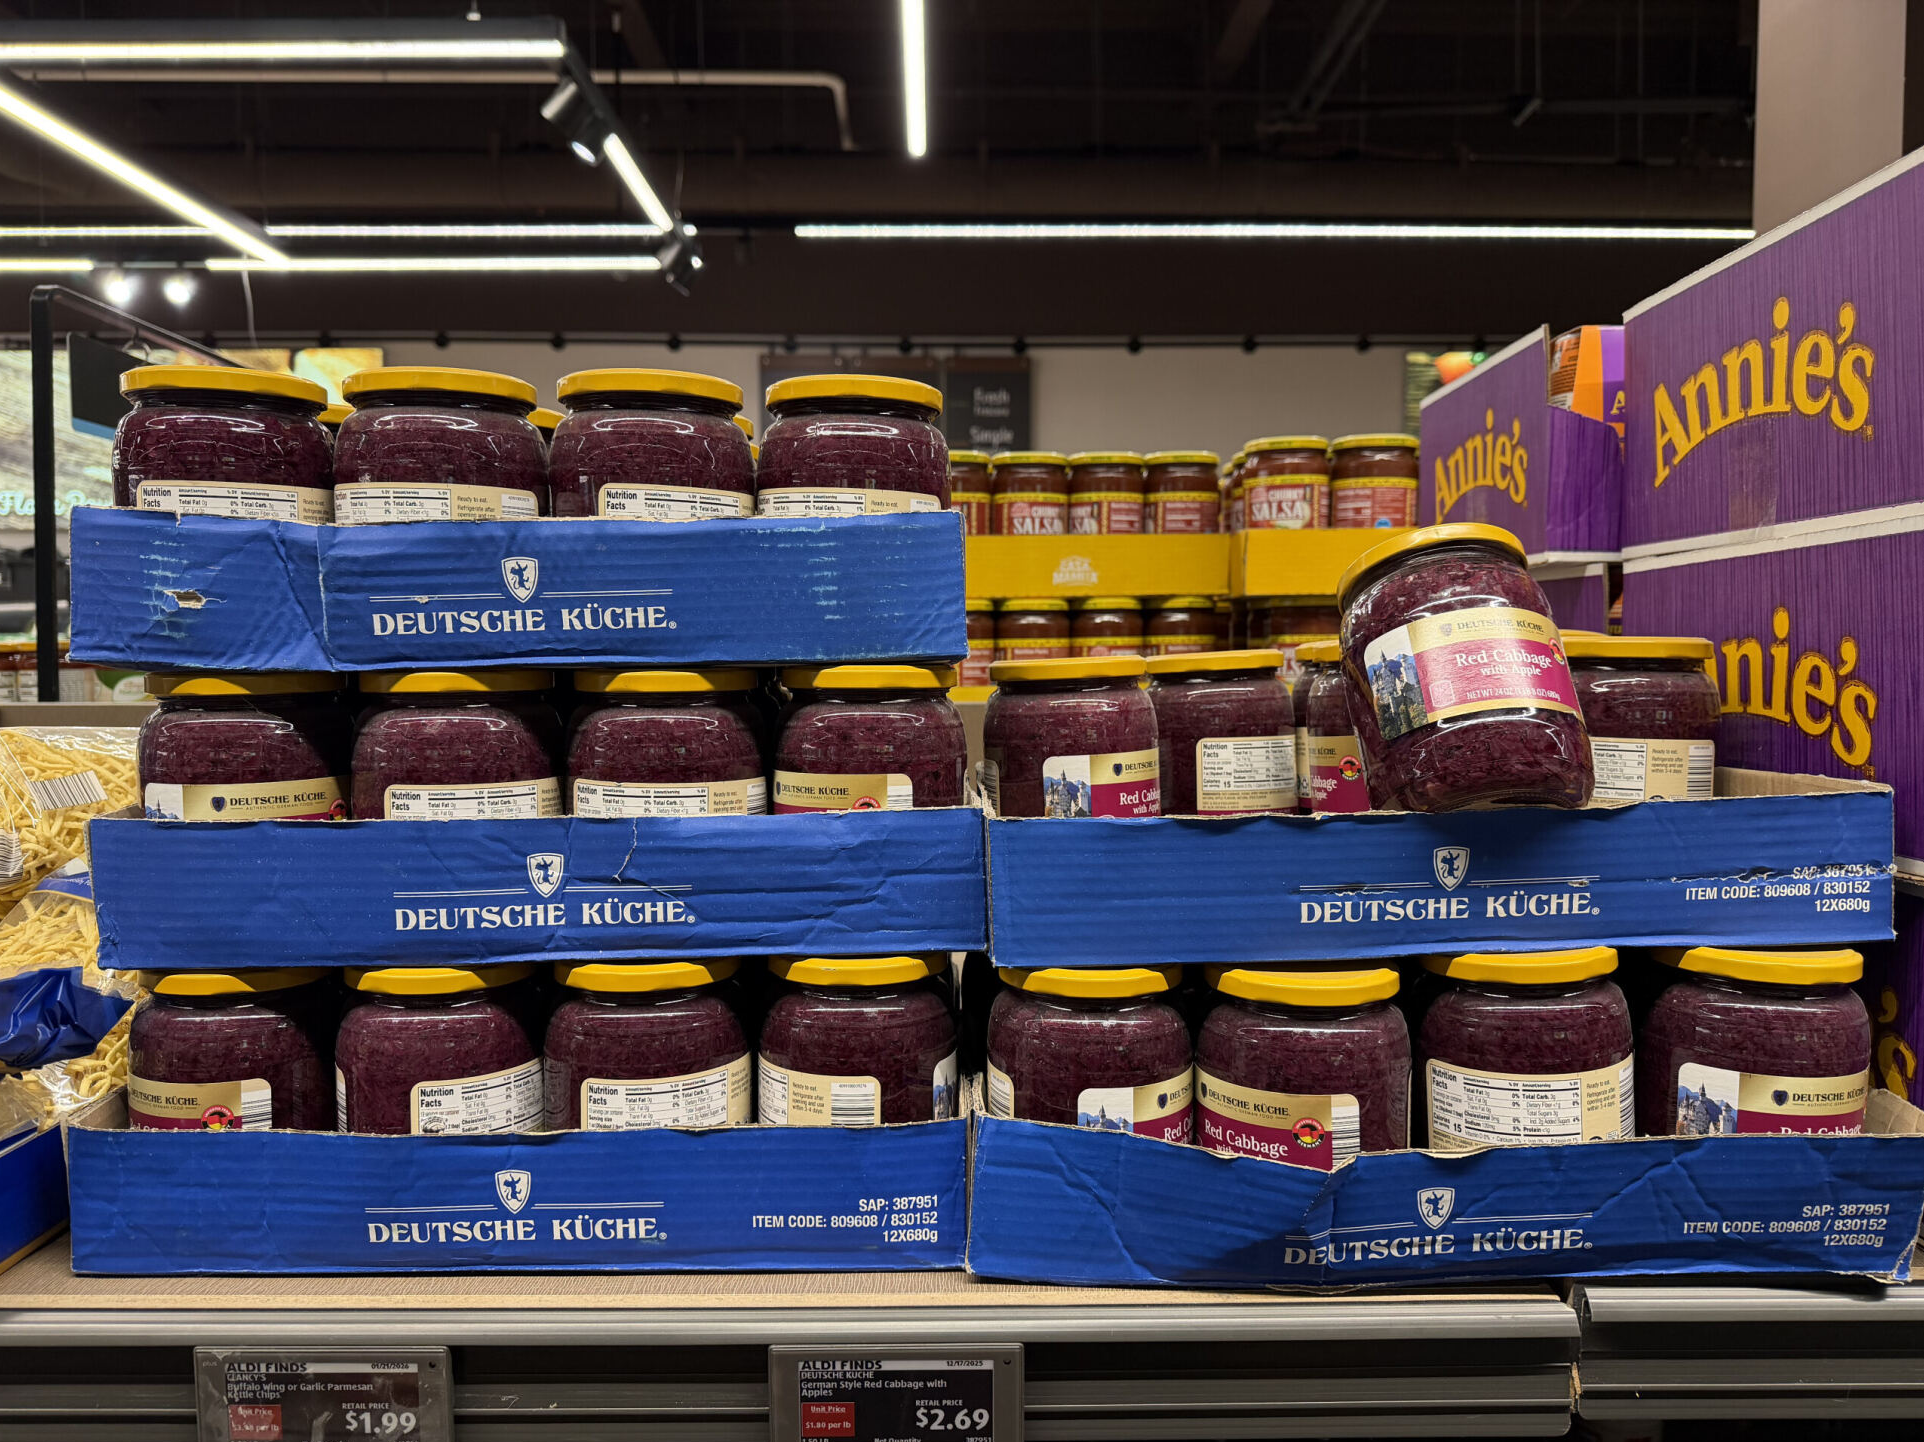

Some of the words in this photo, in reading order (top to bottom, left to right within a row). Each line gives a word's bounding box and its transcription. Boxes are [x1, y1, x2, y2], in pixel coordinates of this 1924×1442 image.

[1654, 296, 1875, 489] Annie's
[1434, 407, 1529, 526] Annie's
[143, 488, 172, 497] Nutrition
[606, 490, 637, 499] Nutrition
[143, 499, 161, 508] Facts
[607, 501, 626, 510] Facts
[1252, 501, 1305, 520] SALSA
[372, 609, 546, 636] DEUTSCHE
[1455, 650, 1488, 666] Red
[1493, 648, 1552, 668] Cabbage
[1481, 665, 1507, 676] with
[1512, 665, 1542, 676] Apple
[577, 785, 597, 795] Nutrition
[781, 784, 815, 794] DEUTSCHE
[230, 795, 290, 806] DEUTSCHE
[391, 792, 421, 801] Nutrition
[577, 796, 590, 804] Facts
[1120, 791, 1139, 805] Red
[392, 802, 410, 811] Facts
[1686, 887, 1717, 900] ITEM
[1721, 886, 1760, 899] CODE:
[1764, 883, 1811, 897] 809608
[1823, 881, 1870, 895] 830152
[1300, 897, 1469, 924] DEUTSCHE
[1815, 898, 1870, 912] 12X680g
[395, 903, 566, 931] DEUTSCHE
[1432, 1067, 1457, 1082] Nutrition
[1433, 1076, 1448, 1089] Facts
[420, 1088, 454, 1097] Nutrition
[589, 1085, 618, 1096] Nutrition
[589, 1096, 607, 1105] Facts
[1208, 1088, 1250, 1110] DEUTSCHE
[1792, 1092, 1844, 1102] DEUTSCHE
[421, 1099, 442, 1108] Facts
[1434, 1112, 1450, 1124] Calories
[1164, 1122, 1181, 1140] Red
[1453, 1123, 1462, 1132] 15
[1204, 1119, 1223, 1141] Red
[1226, 1131, 1289, 1159] Cabbage
[859, 1199, 889, 1212] SAP:
[892, 1195, 938, 1210] 387951
[1802, 1206, 1835, 1218] SAP:
[1839, 1204, 1890, 1216] 387951
[752, 1215, 784, 1228] ITEM
[788, 1215, 827, 1228] CODE:
[830, 1215, 878, 1227] 809608
[891, 1211, 938, 1226] 830152
[367, 1219, 536, 1243] DEUTSCHE
[1683, 1221, 1718, 1234] ITEM
[1722, 1221, 1764, 1234] CODE:
[1769, 1220, 1821, 1233] 809608
[1834, 1219, 1887, 1231] 830152
[882, 1228, 938, 1243] 12X680g
[1823, 1234, 1884, 1247] 12X680g
[1284, 1234, 1455, 1266] DEUTSCHE
[227, 1362, 263, 1373] ALDI
[266, 1362, 308, 1373] FINDS
[371, 1362, 410, 1370] 01/21/2026
[801, 1360, 837, 1370] ALDI
[841, 1361, 882, 1370] FINDS
[227, 1374, 266, 1382] CLANCY'S
[801, 1371, 847, 1379] DEUTSCHE
[227, 1382, 260, 1392] Buffalo
[263, 1382, 285, 1393] Wing
[300, 1382, 326, 1391] Garlic
[328, 1383, 373, 1391] Parmesan
[801, 1381, 837, 1389] German
[840, 1380, 862, 1390] Style
[864, 1380, 882, 1388] Red
[884, 1380, 924, 1389] Cabbage
[927, 1380, 948, 1388] with
[227, 1391, 254, 1399] Kettle
[256, 1391, 281, 1400] Chips
[801, 1389, 833, 1398] Apples
[345, 1411, 417, 1434] $1.99
[828, 1422, 842, 1430] per
[844, 1420, 851, 1428] lb
[915, 1408, 990, 1431] $2.69
